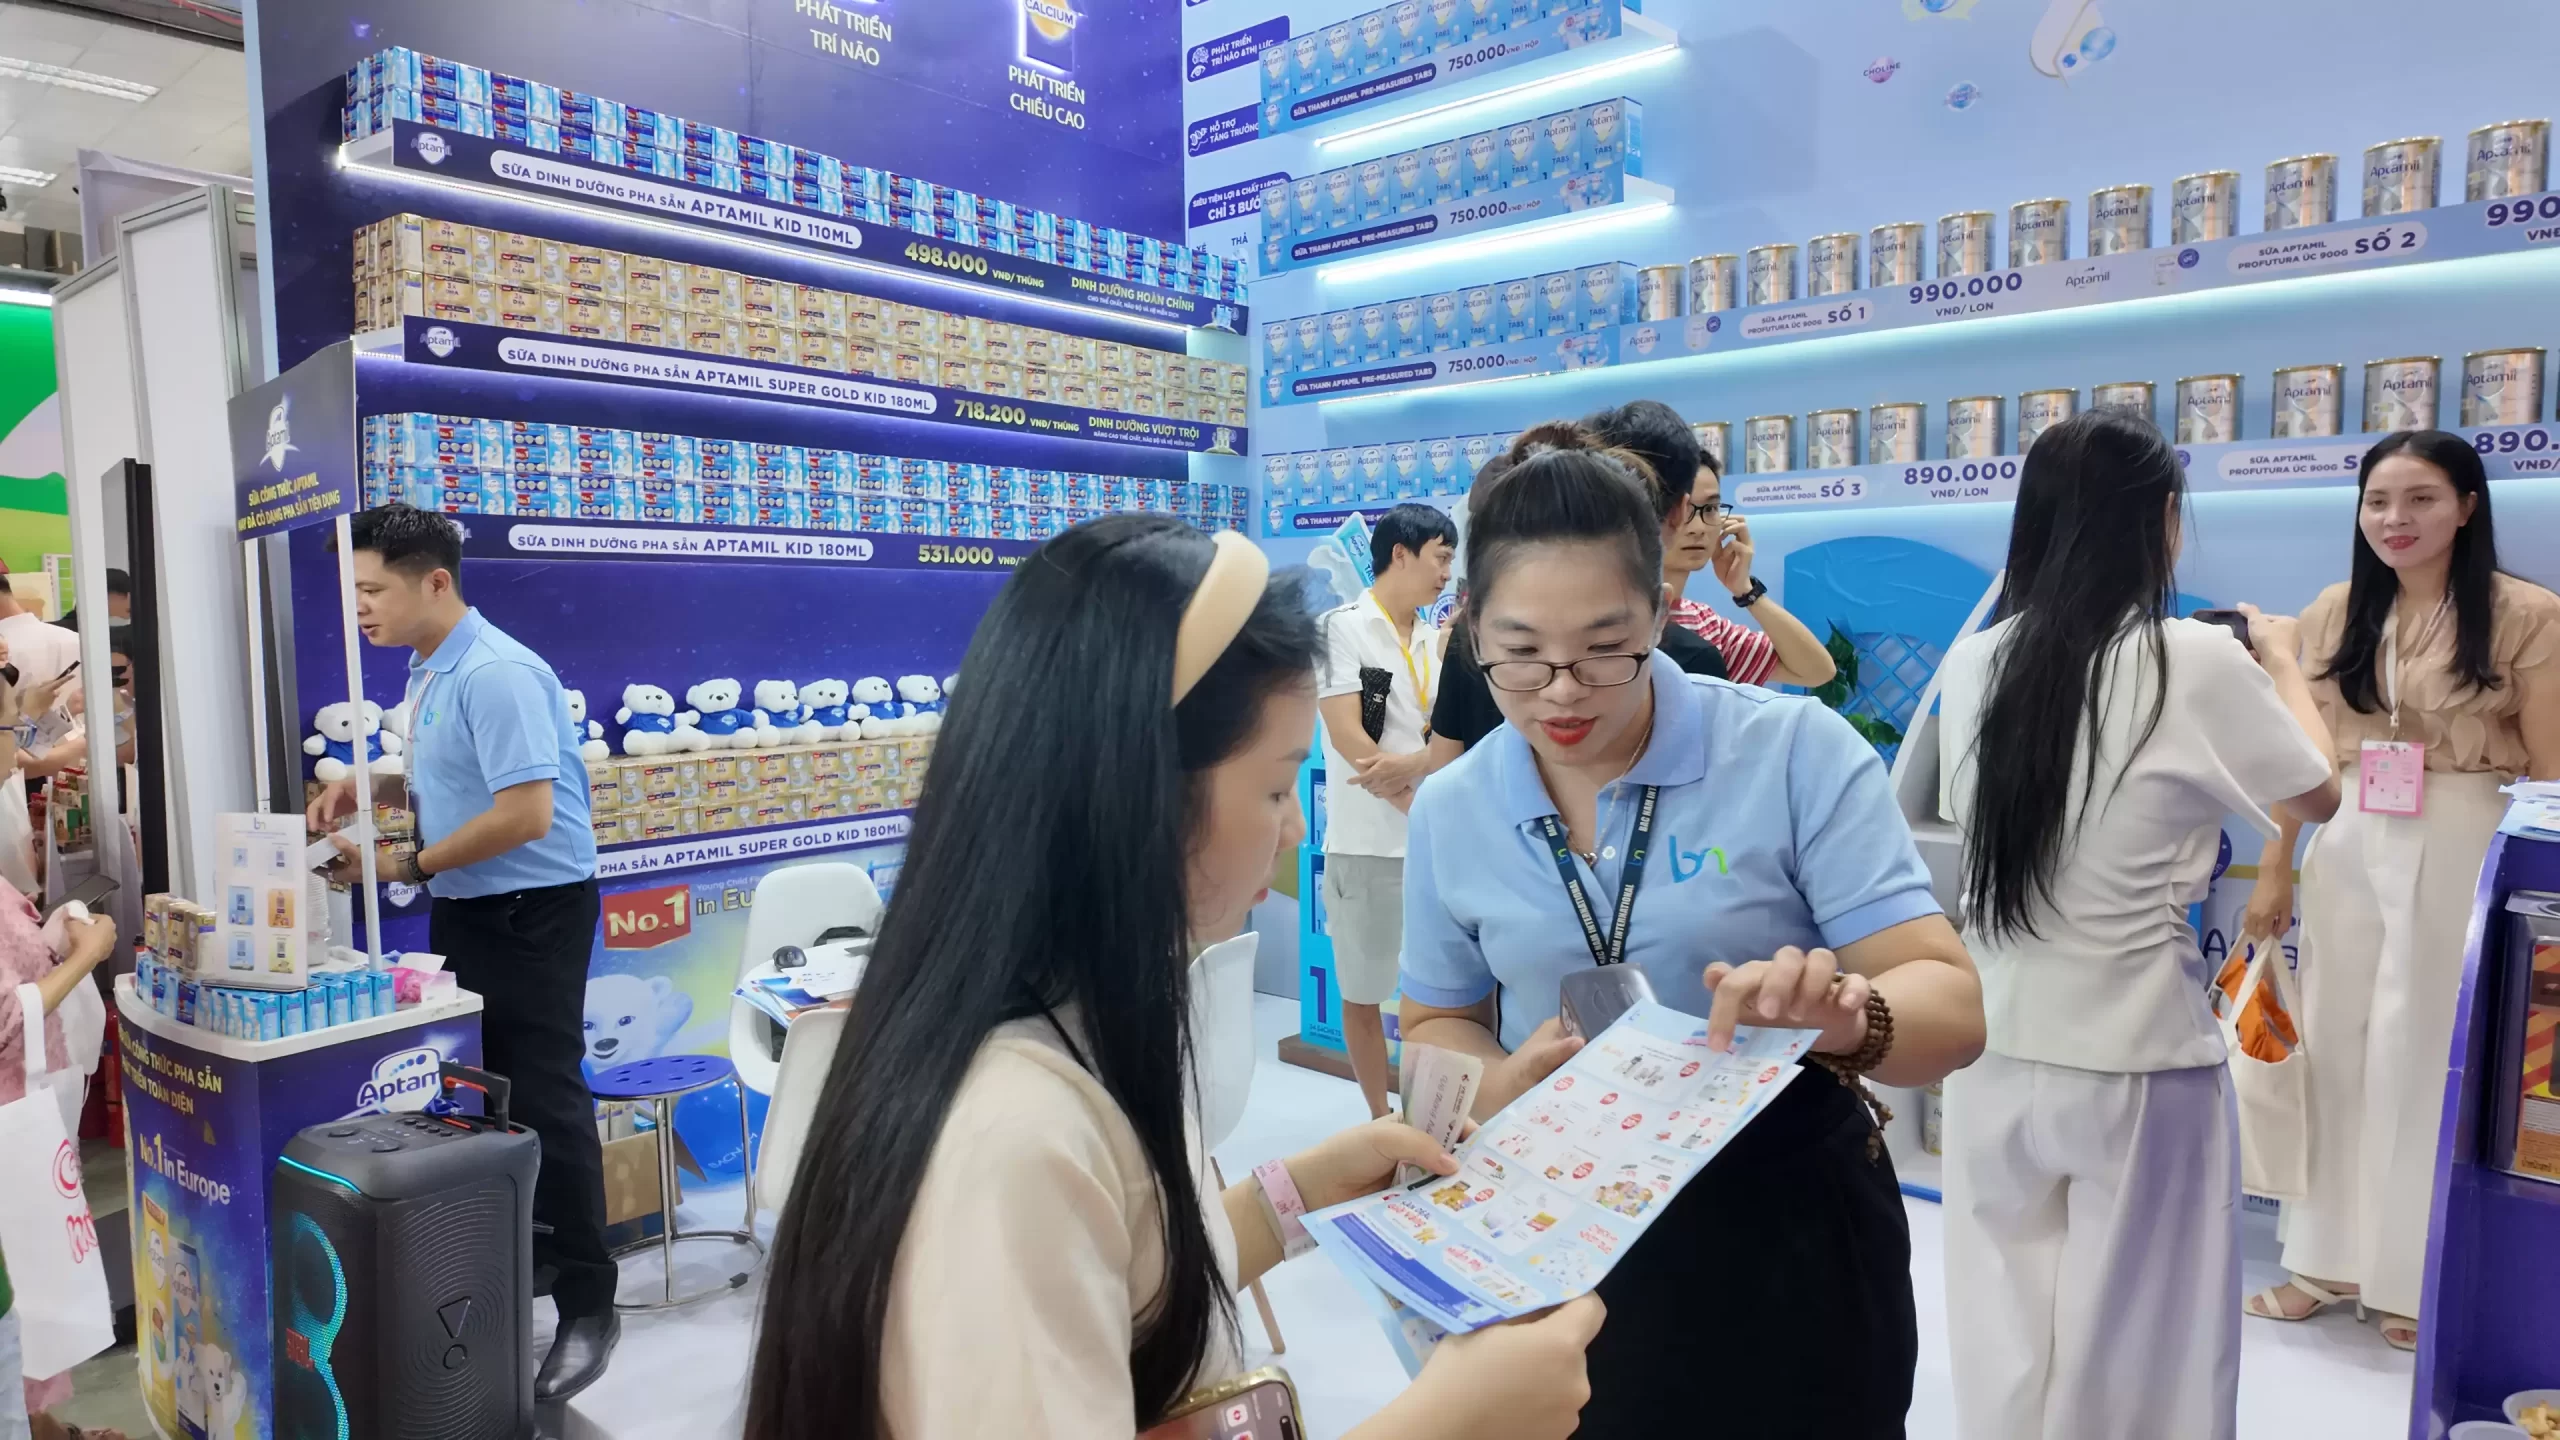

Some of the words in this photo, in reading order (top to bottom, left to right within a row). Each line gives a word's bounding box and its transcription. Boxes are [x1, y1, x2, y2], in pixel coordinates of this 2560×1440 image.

[1025, 1, 1075, 25] CALCIUM
[843, 10, 892, 42] TRIỂN
[809, 29, 838, 54] TRÍ
[841, 40, 880, 66] NÃO
[1448, 44, 1506, 72] 750.000
[1863, 61, 1901, 77] CHOLINE
[1009, 65, 1046, 91] PHÁT
[1046, 77, 1085, 105] TRIỂN
[1055, 107, 1085, 130] CAO
[1586, 111, 1620, 127] Aptamil
[1543, 121, 1577, 138] Aptamil
[1551, 154, 1570, 165] TABS
[1594, 145, 1613, 156] TABS
[2370, 159, 2419, 179] Aptamil
[501, 159, 531, 180] SỮA
[536, 168, 570, 187] DINH
[575, 173, 625, 199] DƯỠNG
[628, 188, 656, 206] PHA
[659, 192, 687, 211] SẴN
[690, 198, 768, 228] APTAMIL
[773, 216, 802, 234] KID
[808, 223, 854, 246] 110ML
[2095, 205, 2139, 220] Aptamil
[1449, 201, 1508, 225] 750.000
[2015, 217, 2056, 233] Aptamil
[1231, 232, 1249, 246] THẢ
[2258, 247, 2280, 257] SỮA
[2282, 240, 2328, 254] APTAMIL
[2354, 227, 2391, 254] SỐ
[2400, 231, 2417, 249] 2
[904, 242, 988, 277] 498.000
[2237, 255, 2300, 271] PROFUTURA
[2301, 250, 2318, 263] ÚC
[2319, 248, 2348, 260] 900G
[1540, 281, 1572, 296] Aptamil
[1580, 275, 1615, 291] Aptamil
[1909, 272, 2023, 305] 990.000
[2065, 270, 2111, 289] Aptamil
[1071, 276, 1097, 292] DINH
[1099, 281, 1135, 301] DƯỠNG
[1136, 289, 1165, 306] HOÀN
[1165, 294, 1195, 312] CHỈNH
[1589, 307, 1607, 317] TABS
[1827, 302, 1854, 324] SỐ
[1858, 305, 1866, 320] 1
[1967, 301, 1994, 313] LON
[1761, 315, 1777, 325] SỮA
[1777, 310, 1808, 323] APTAMIL
[1629, 332, 1661, 347] Aptamil
[507, 345, 537, 363] SỮA
[541, 353, 576, 367] DINH
[581, 354, 629, 373] DƯỠNG
[633, 363, 660, 376] PHA
[664, 363, 690, 380] SẴN
[695, 369, 764, 389] APTAMIL
[768, 378, 816, 395] SUPER
[821, 385, 859, 401] GOLD
[864, 391, 886, 405] KID
[891, 395, 931, 411] 180ML
[1294, 381, 1309, 393] SỮA
[1309, 379, 1332, 391] THANH
[1332, 375, 1361, 388] APTAMIL
[1361, 369, 1414, 384] PRE-MEASURED
[1414, 365, 1433, 377] TABS
[1448, 353, 1505, 374] 750.000
[2467, 369, 2518, 386] Aptamil
[2284, 385, 2331, 400] Aptamil
[2382, 376, 2433, 393] Aptamil
[953, 399, 1026, 425] 718.200
[1088, 416, 1114, 430] DINH
[1115, 419, 1150, 434] DƯỠNG
[1152, 423, 1177, 439] VƯỢT
[1177, 425, 1200, 439] TRỘI
[1461, 446, 1492, 458] Aptamil
[2474, 429, 2560, 455] 890.
[1425, 449, 1453, 461] Aptamil
[2249, 455, 2271, 465] SỮA
[2272, 453, 2317, 464] APTAMIL
[1904, 461, 2018, 485] 890.000
[2228, 465, 2290, 477] PROFUTURA
[2292, 463, 2307, 473] ÚC
[2309, 463, 2338, 473] 900G
[1820, 478, 1845, 498] SỐ
[1851, 483, 1861, 496] 3
[1964, 486, 1989, 498] LON
[517, 534, 547, 547] SỮA
[551, 537, 585, 548] DINH
[589, 535, 638, 550] DƯỠNG
[642, 540, 669, 552] PHA
[672, 537, 698, 552] SẴN
[703, 539, 780, 555] APTAMIL
[785, 542, 813, 556] KID
[819, 543, 867, 557] 180ML
[918, 544, 994, 564] 531.000
[1643, 798, 1655, 817] NAM
[1638, 817, 1649, 833] BAC
[600, 861, 627, 875] PHA
[631, 854, 658, 869] SẴN
[663, 844, 733, 866] APTAMIL
[739, 836, 788, 855] SUPER
[792, 831, 832, 847] GOLD
[836, 828, 860, 842] KID
[864, 822, 905, 838] 180ML
[607, 887, 689, 938] No.1
[695, 897, 717, 916] in
[1568, 879, 1595, 933] INTERNATIONAL
[1616, 883, 1635, 936] INTERNATIONAL
[1590, 932, 1604, 952] NAM
[1611, 936, 1622, 957] NAM
[150, 1051, 173, 1077] THỨC
[173, 1063, 195, 1086] PHA
[197, 1065, 222, 1093] SẴN
[147, 1078, 170, 1104] TOÀN
[170, 1091, 194, 1115] DIỆN
[177, 1161, 231, 1206] Europe
